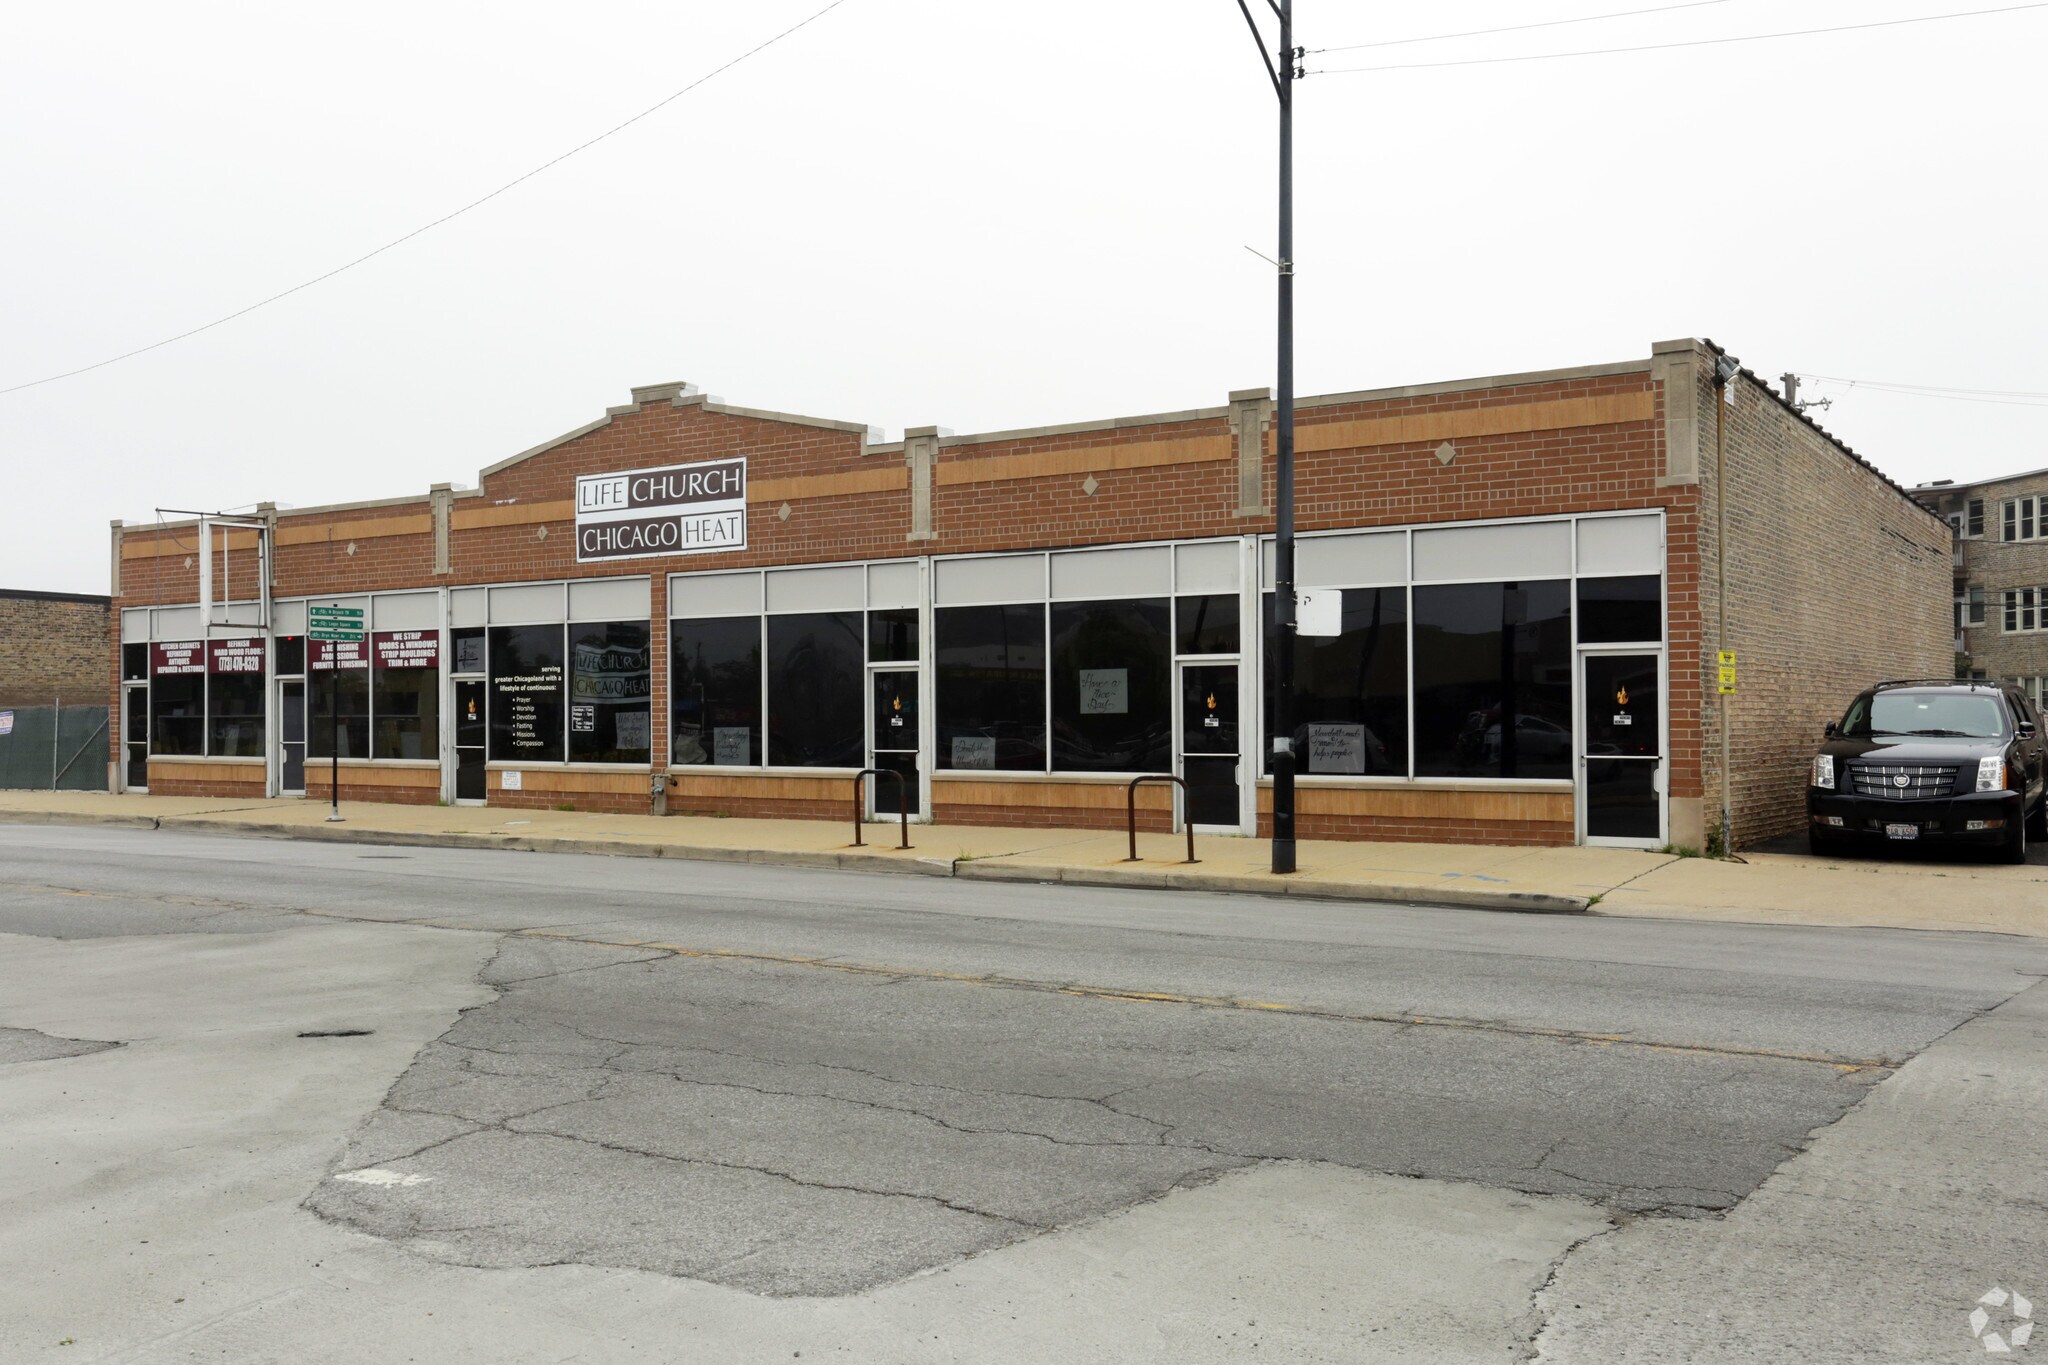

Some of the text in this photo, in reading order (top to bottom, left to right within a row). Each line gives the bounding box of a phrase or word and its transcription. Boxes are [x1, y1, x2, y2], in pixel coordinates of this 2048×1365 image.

[583, 468, 740, 506] LIFE CHURCH
[583, 517, 738, 552] CHICAGO HEAT
[404, 632, 421, 640] STRIP
[406, 640, 437, 648] WINDOWS
[381, 649, 435, 658] STRIP MOULDINGS
[341, 660, 367, 668] FINISHING
